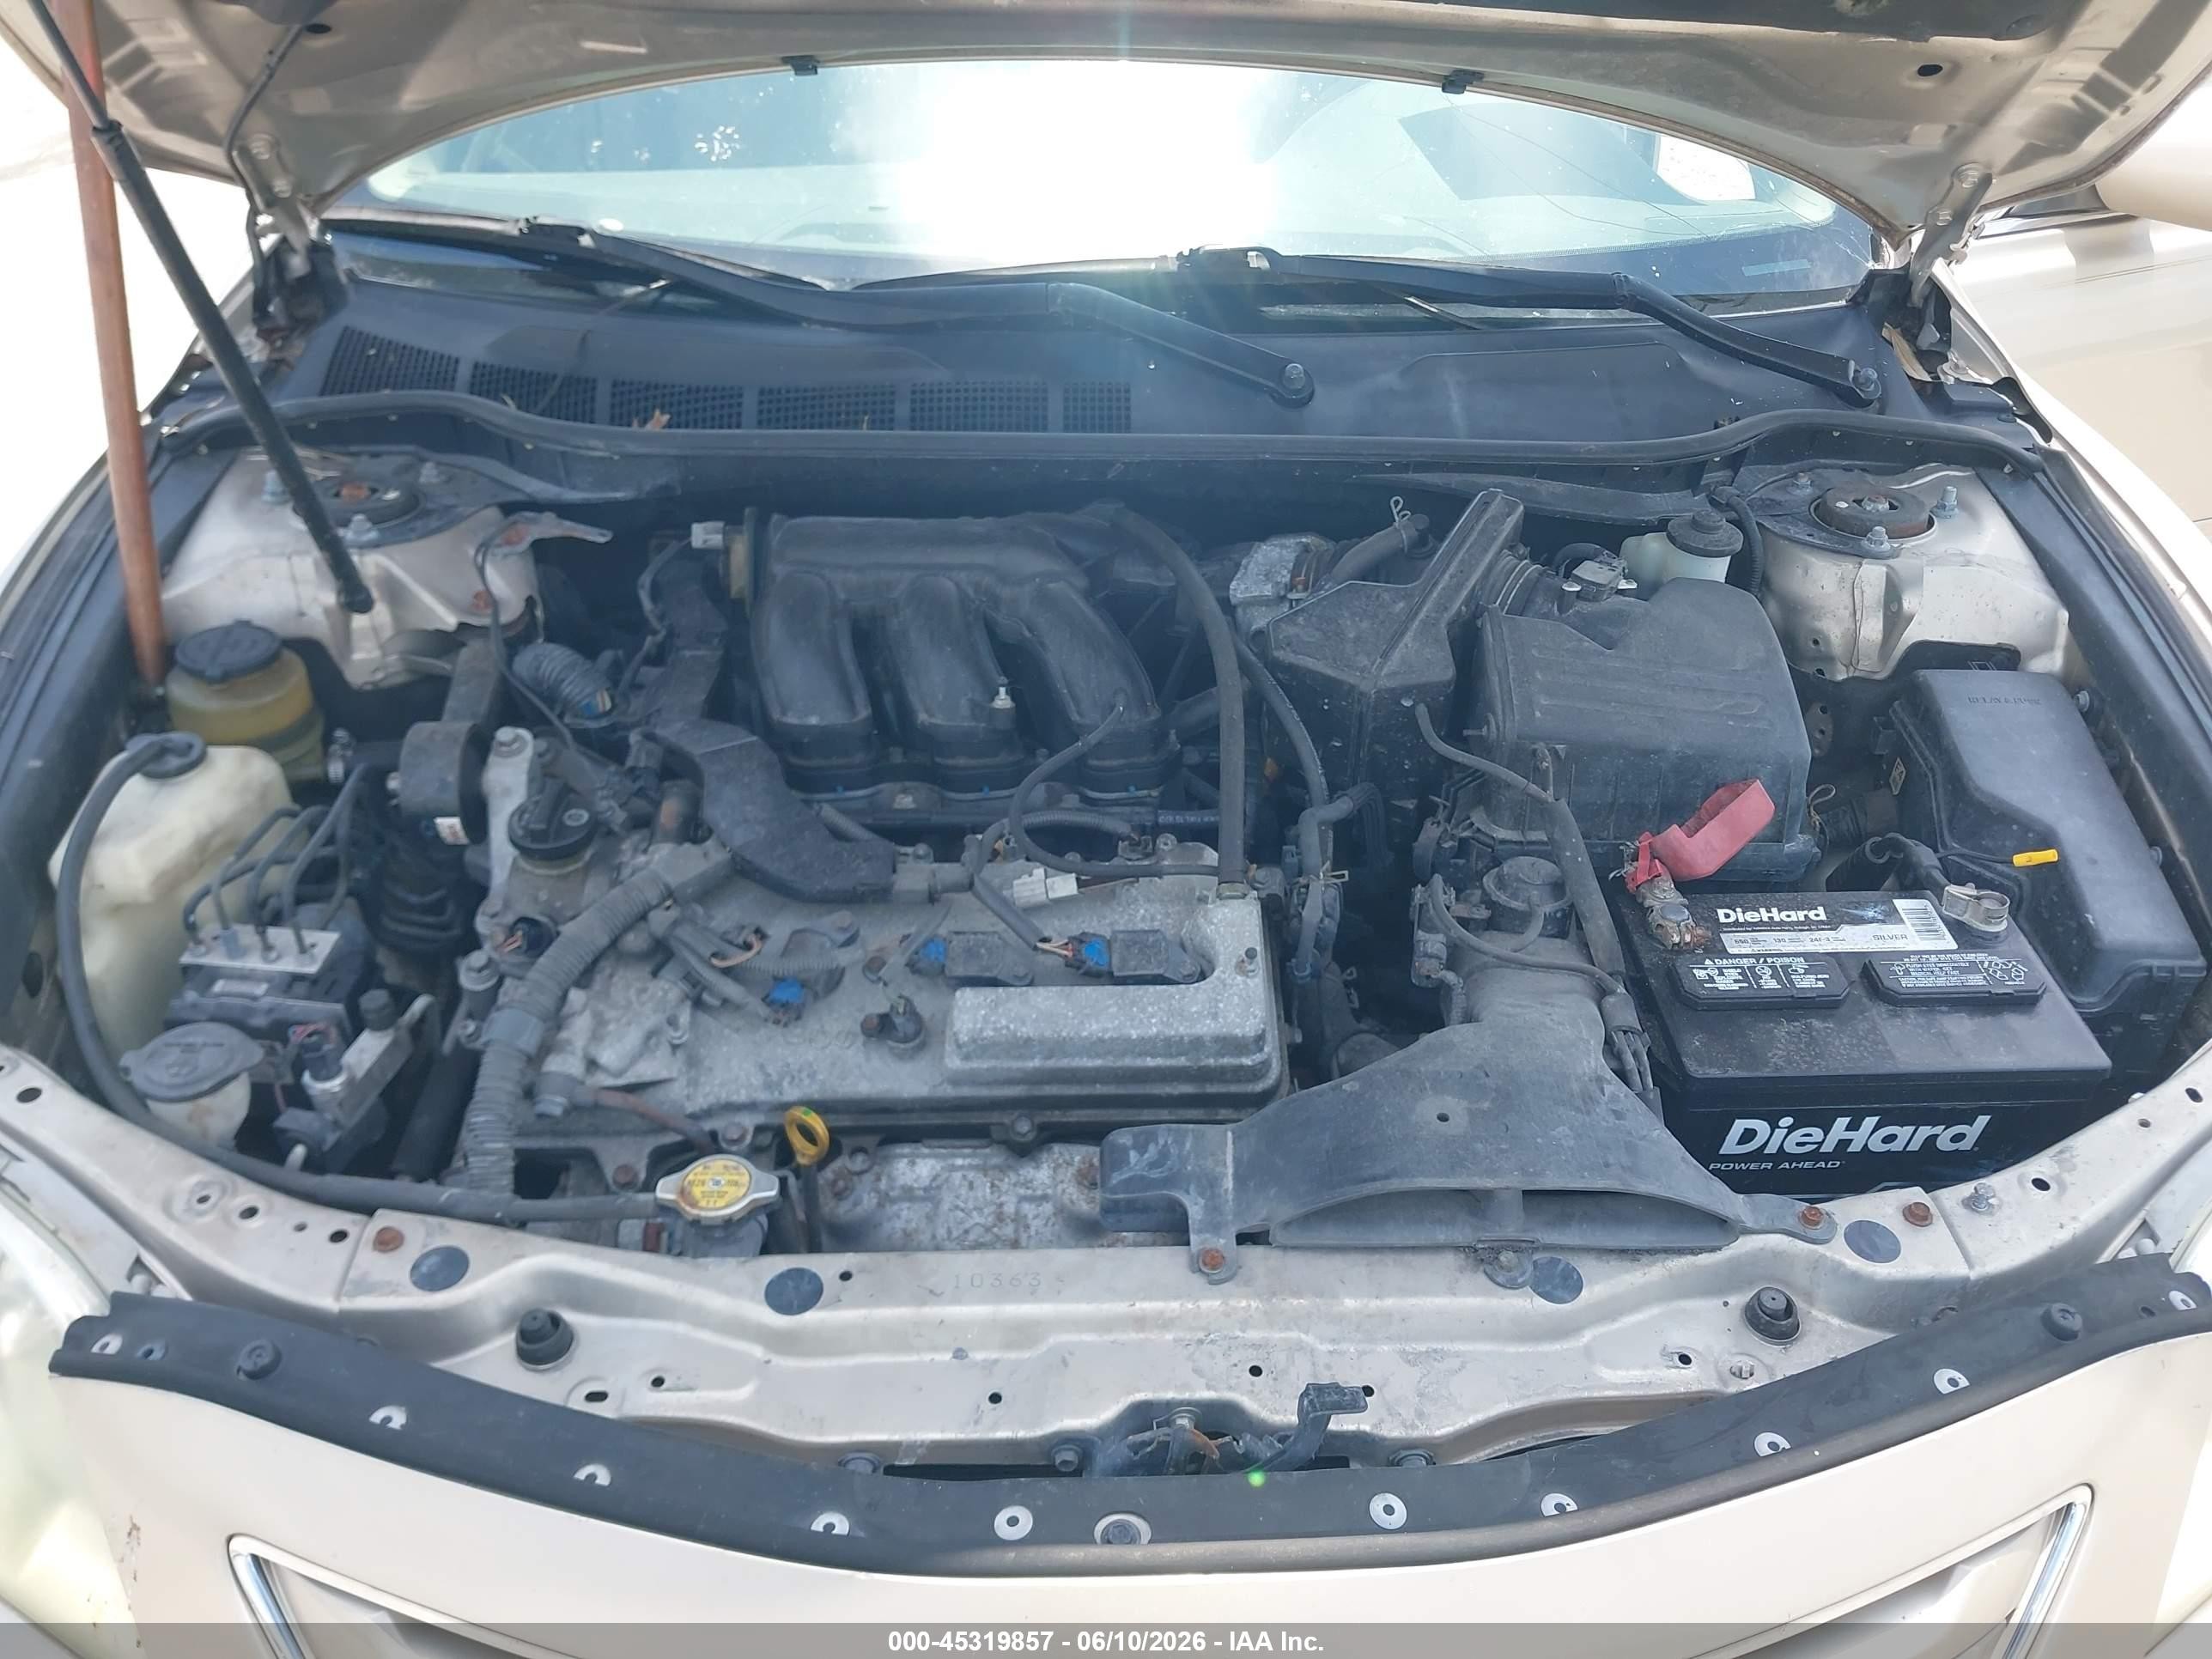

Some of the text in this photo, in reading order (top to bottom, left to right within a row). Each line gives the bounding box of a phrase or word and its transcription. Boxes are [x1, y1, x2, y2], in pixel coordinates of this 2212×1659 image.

[1717, 906, 1827, 923] DieHard
[1719, 1115, 1991, 1154] DieHard
[1709, 1161, 1840, 1170] POWER AHEAD
[954, 1272, 1042, 1289] 10363
